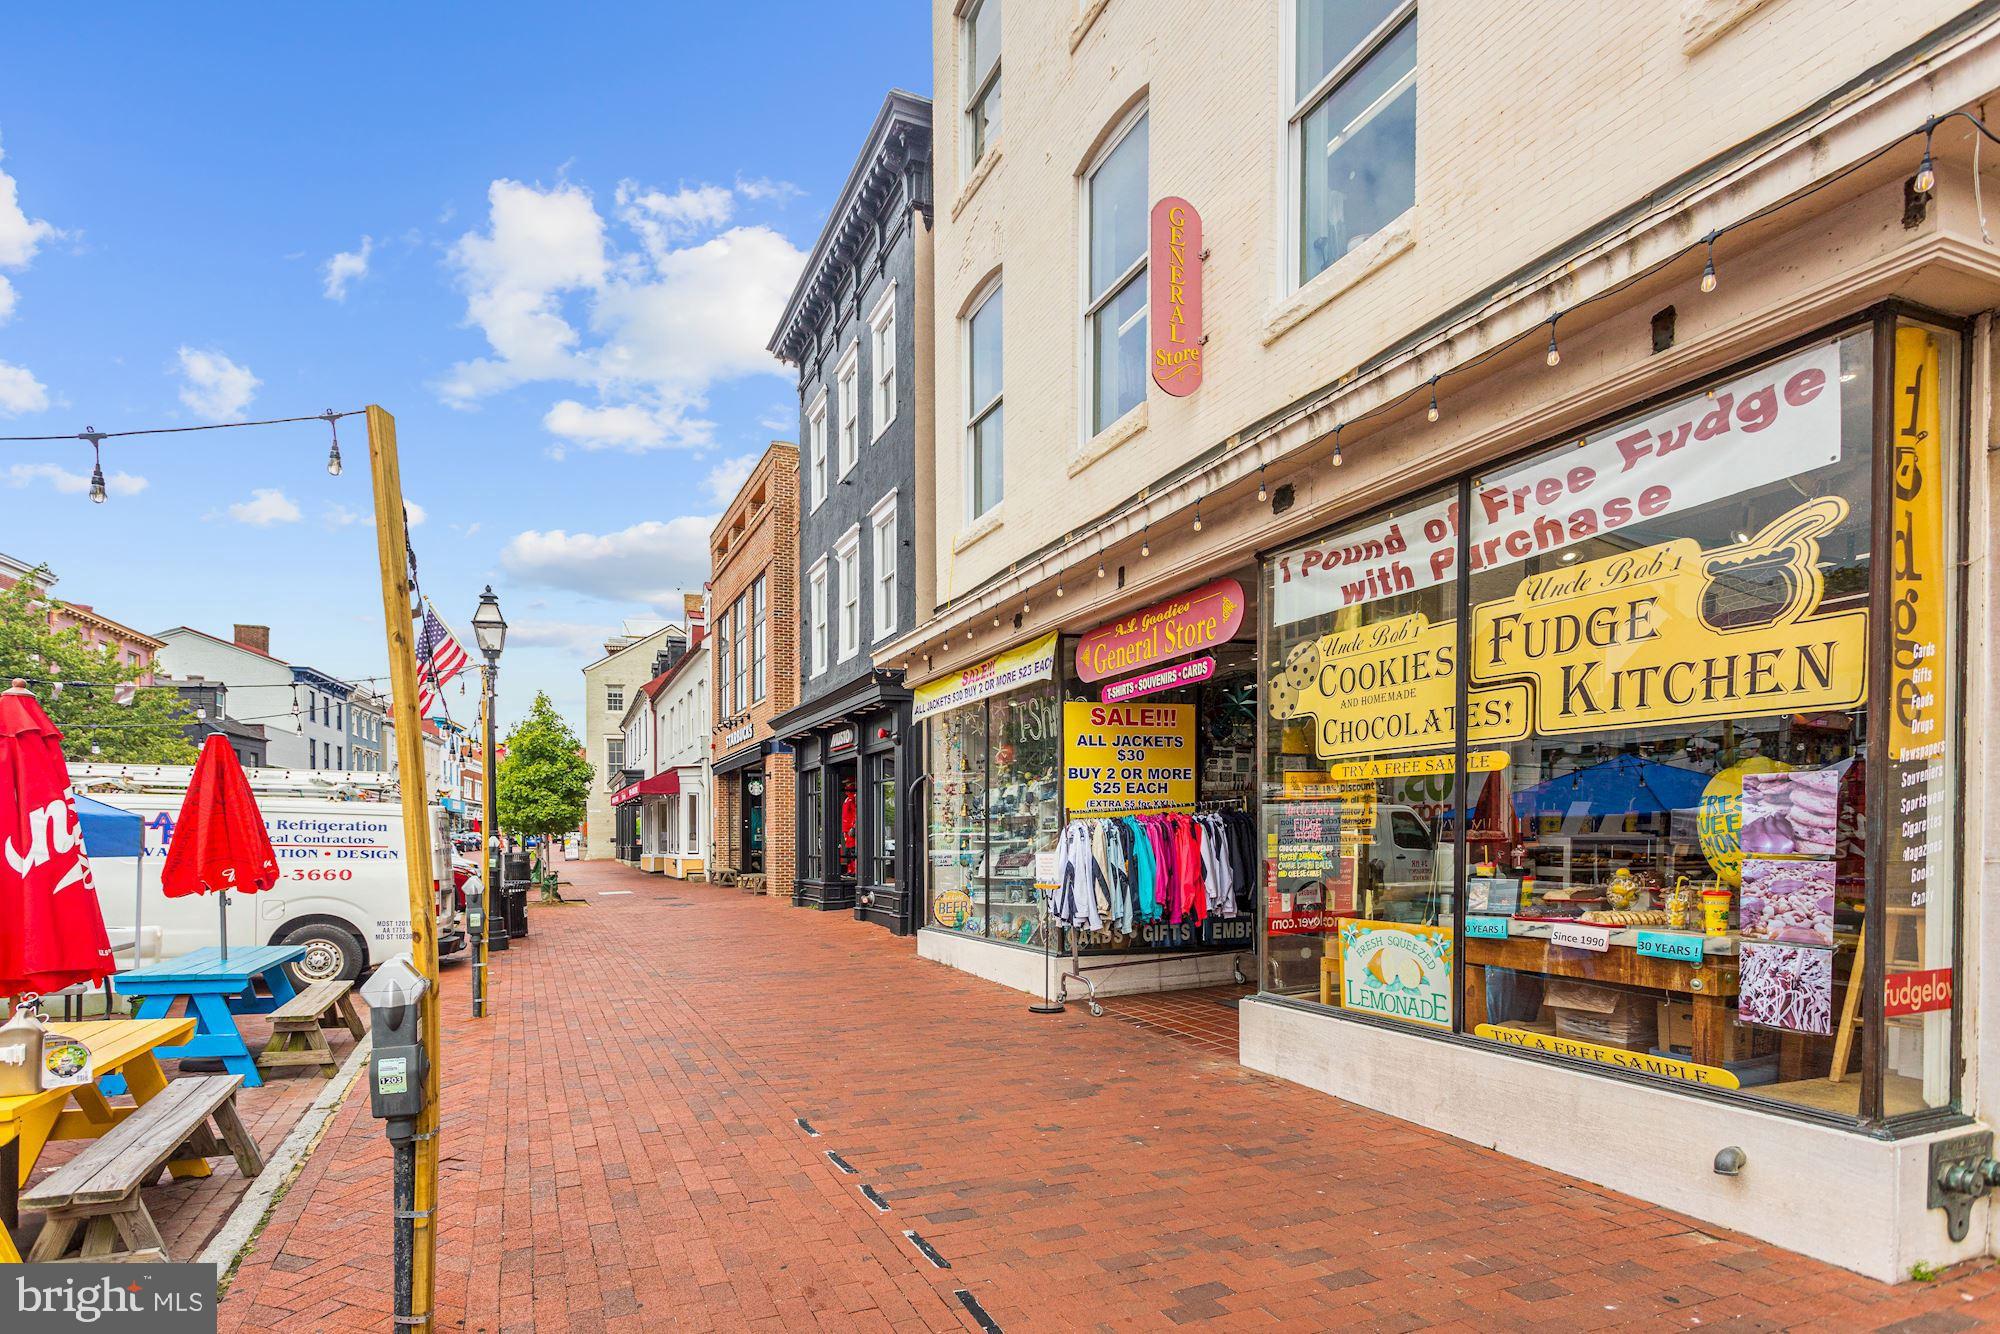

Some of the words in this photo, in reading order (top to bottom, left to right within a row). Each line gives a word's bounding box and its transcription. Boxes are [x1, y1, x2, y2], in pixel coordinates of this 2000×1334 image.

[1169, 207, 1185, 344] GENERAL
[1155, 347, 1200, 367] Store
[1280, 557, 1291, 583] 1
[1302, 524, 1407, 577] Pound
[1480, 466, 1597, 525] Free
[1616, 367, 1826, 473] Fudge
[1341, 561, 1415, 605] with
[1527, 569, 1588, 602] Uncle
[1600, 547, 1682, 587] Bob's
[1142, 601, 1191, 632] Goodies
[1322, 633, 1364, 657] Uncle
[1369, 618, 1419, 649] Bob's
[1487, 596, 1661, 666] FUDGE
[1093, 626, 1158, 675] General
[1163, 616, 1217, 655] Store
[1913, 641, 1936, 660] Cards
[1106, 682, 1134, 700] T-SHIRTS
[1137, 670, 1177, 691] SOUVENIRS
[1182, 661, 1208, 680] CARDS
[1319, 646, 1455, 697] COOKIES
[1559, 640, 1839, 719] KITCHEN
[1912, 667, 1933, 684] Gifts
[914, 705, 926, 715] ALL
[926, 694, 951, 712] JACKETS
[964, 685, 977, 699] BUY
[978, 682, 984, 694] 2
[984, 679, 995, 691] OR
[996, 672, 1017, 687] MORE
[1340, 697, 1360, 709] AND
[1361, 688, 1417, 705] HOMEMADE
[1911, 692, 1934, 710] Foods
[1091, 707, 1176, 727] SALE!!!
[1911, 717, 1935, 735] Drugs
[1077, 735, 1107, 746] ALL
[1112, 735, 1183, 748] JACKETS
[1900, 739, 1946, 763] Newspapers
[1117, 749, 1145, 762] $30
[1068, 767, 1101, 779] BUY
[1107, 767, 1116, 779] 2
[1121, 768, 1143, 779] OR
[1148, 768, 1192, 780] MORE
[1341, 764, 1367, 778] TRY
[1369, 763, 1381, 776] A
[1384, 760, 1421, 775] FREE
[1425, 754, 1490, 772] SAMLE
[1093, 782, 1121, 795] $25
[1126, 782, 1168, 794] EACH
[1340, 781, 1375, 793] Discount
[1086, 800, 1121, 808] (EXTRA
[1124, 800, 1135, 808] $5
[1138, 800, 1150, 808] for
[1900, 790, 1945, 815] Sportswear
[277, 820, 388, 833] Refrigeration
[1902, 814, 1942, 838] Cigarettes
[294, 834, 374, 844] Contractors
[337, 850, 398, 859] DESIGN
[1902, 839, 1943, 862] Magazines
[939, 901, 970, 914] BEER
[1911, 889, 1934, 907] Candy
[1142, 923, 1191, 942] GIFTS
[1472, 923, 1499, 934] YEARS
[1552, 931, 1578, 945] Since
[1580, 934, 1605, 948] 1990
[1638, 941, 1652, 951] 30
[1654, 942, 1692, 956] YEARS
[1356, 935, 1384, 958] FRESH
[1387, 935, 1437, 970] SQUEEZED
[1346, 979, 1449, 1023] LEMONADE
[1490, 1029, 1528, 1044] TRY
[1534, 1038, 1547, 1050] A
[1553, 1042, 1605, 1061] FREE
[1613, 1053, 1709, 1084] SAMPLE
[380, 1077, 402, 1085] 1203
